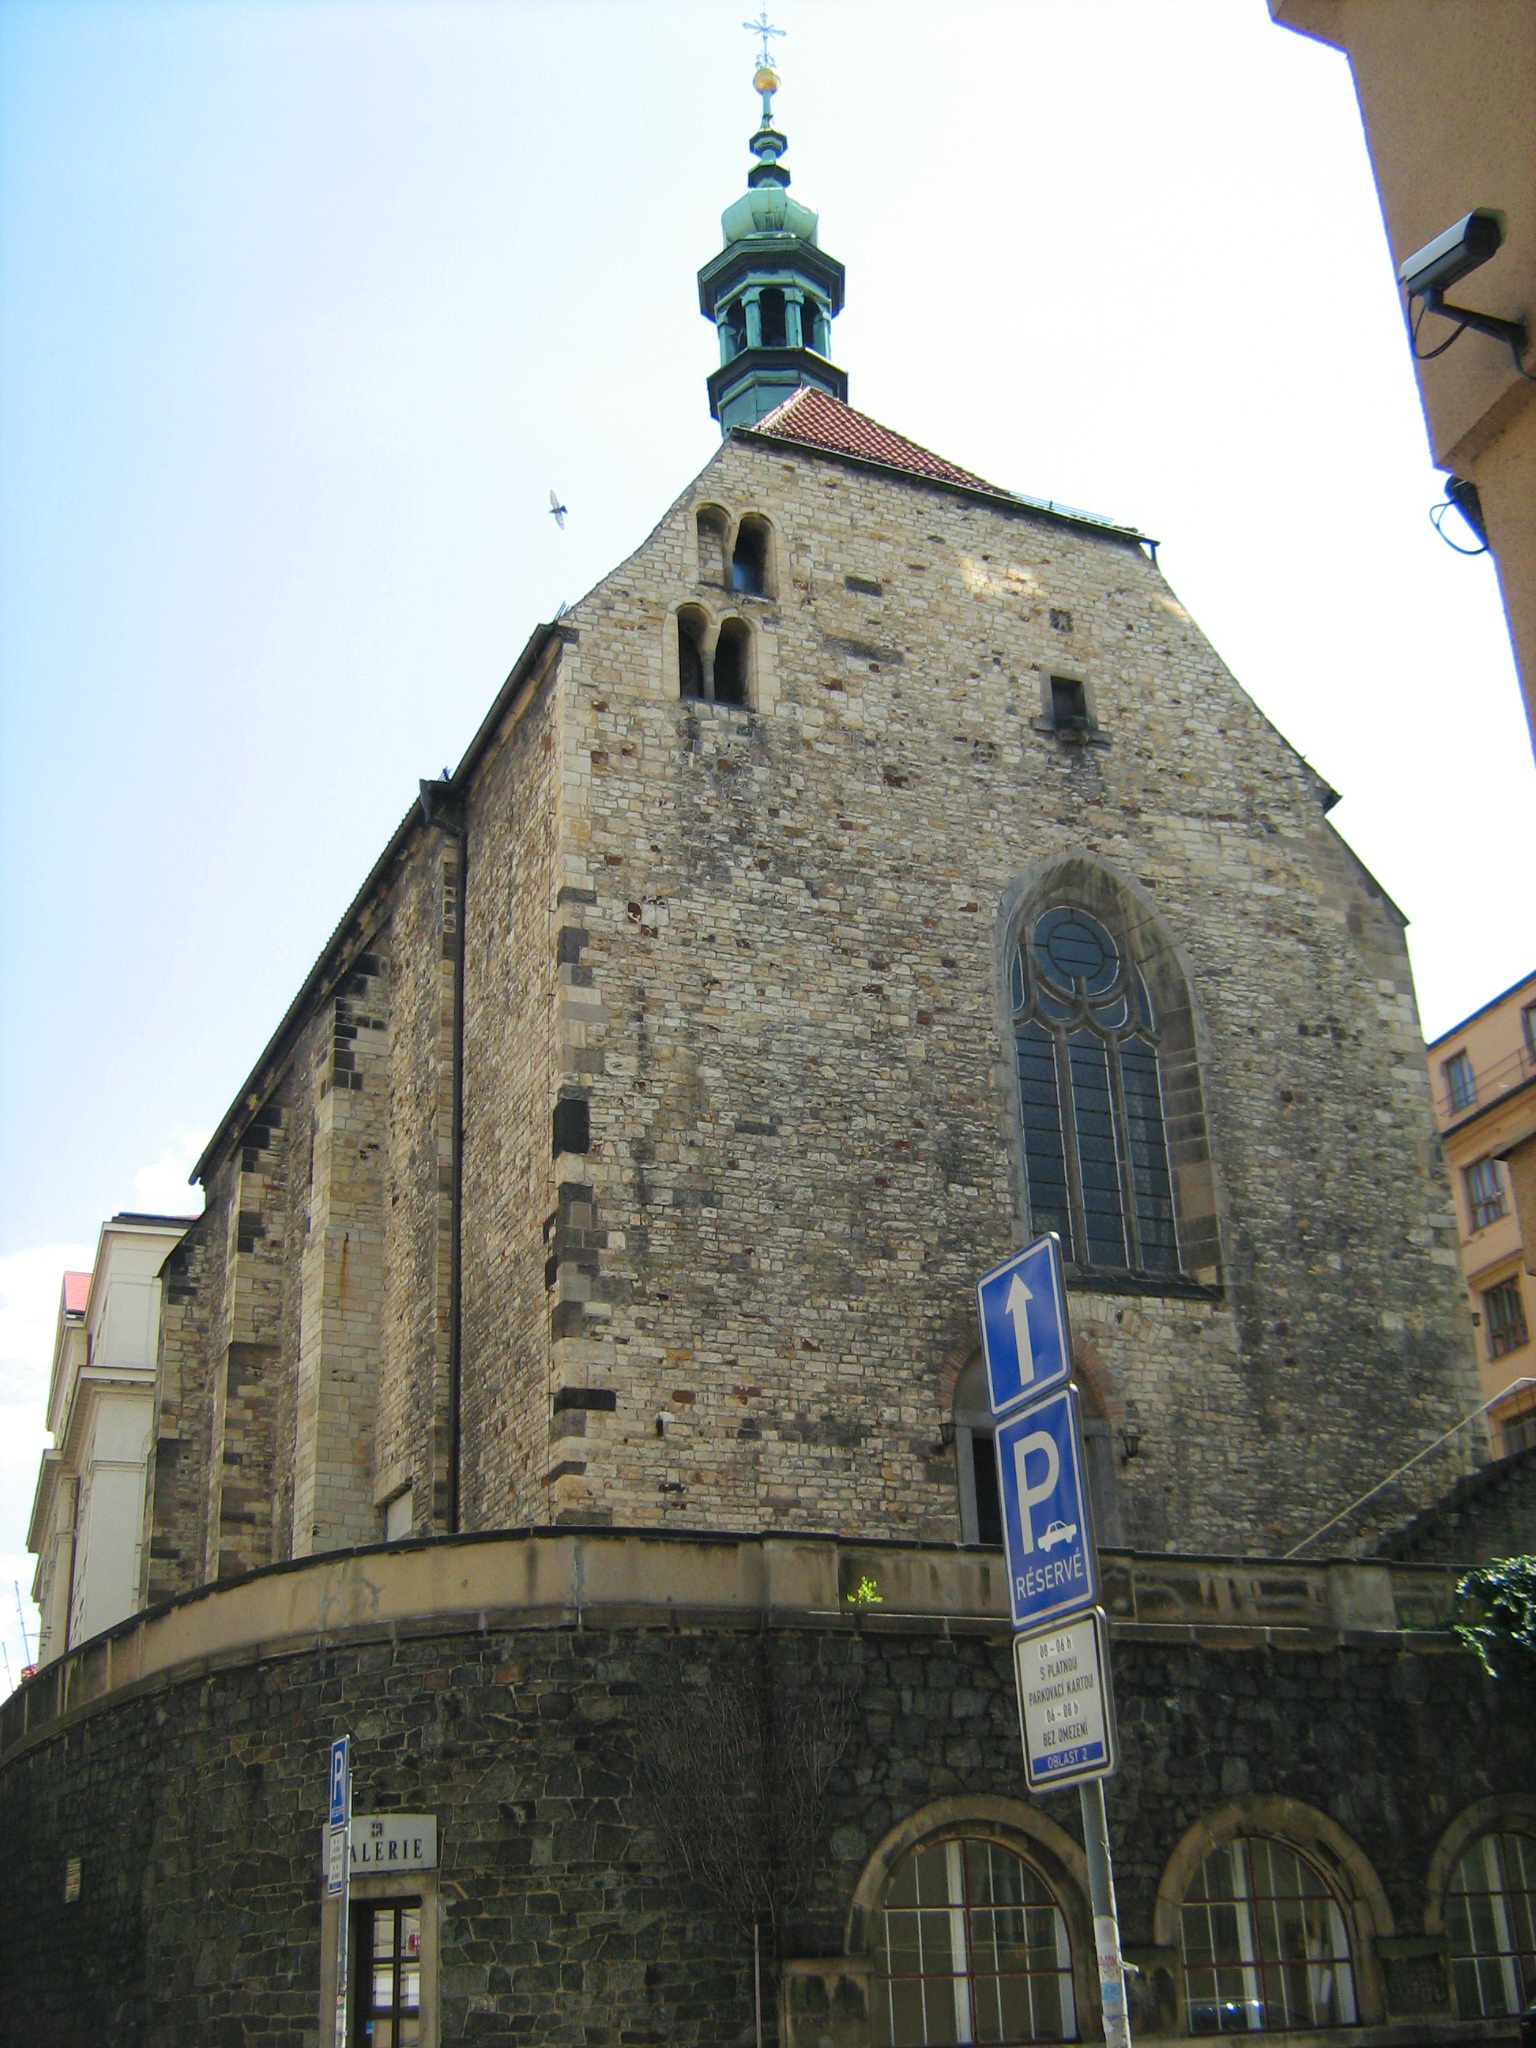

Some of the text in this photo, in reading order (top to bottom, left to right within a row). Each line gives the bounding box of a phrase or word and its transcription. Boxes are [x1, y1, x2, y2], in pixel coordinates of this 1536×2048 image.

[1013, 1431, 1060, 1555] P
[1016, 1548, 1083, 1600] RÉSERVÉ
[1040, 1657, 1078, 1681] S PLATNOU
[1029, 1673, 1094, 1707] PARKOVACÍ KARTOU
[1043, 1717, 1089, 1747] BEZ OMEZENÍ
[1048, 1748, 1088, 1770] OBLAST 2
[350, 1838, 423, 1863] ALERIE
